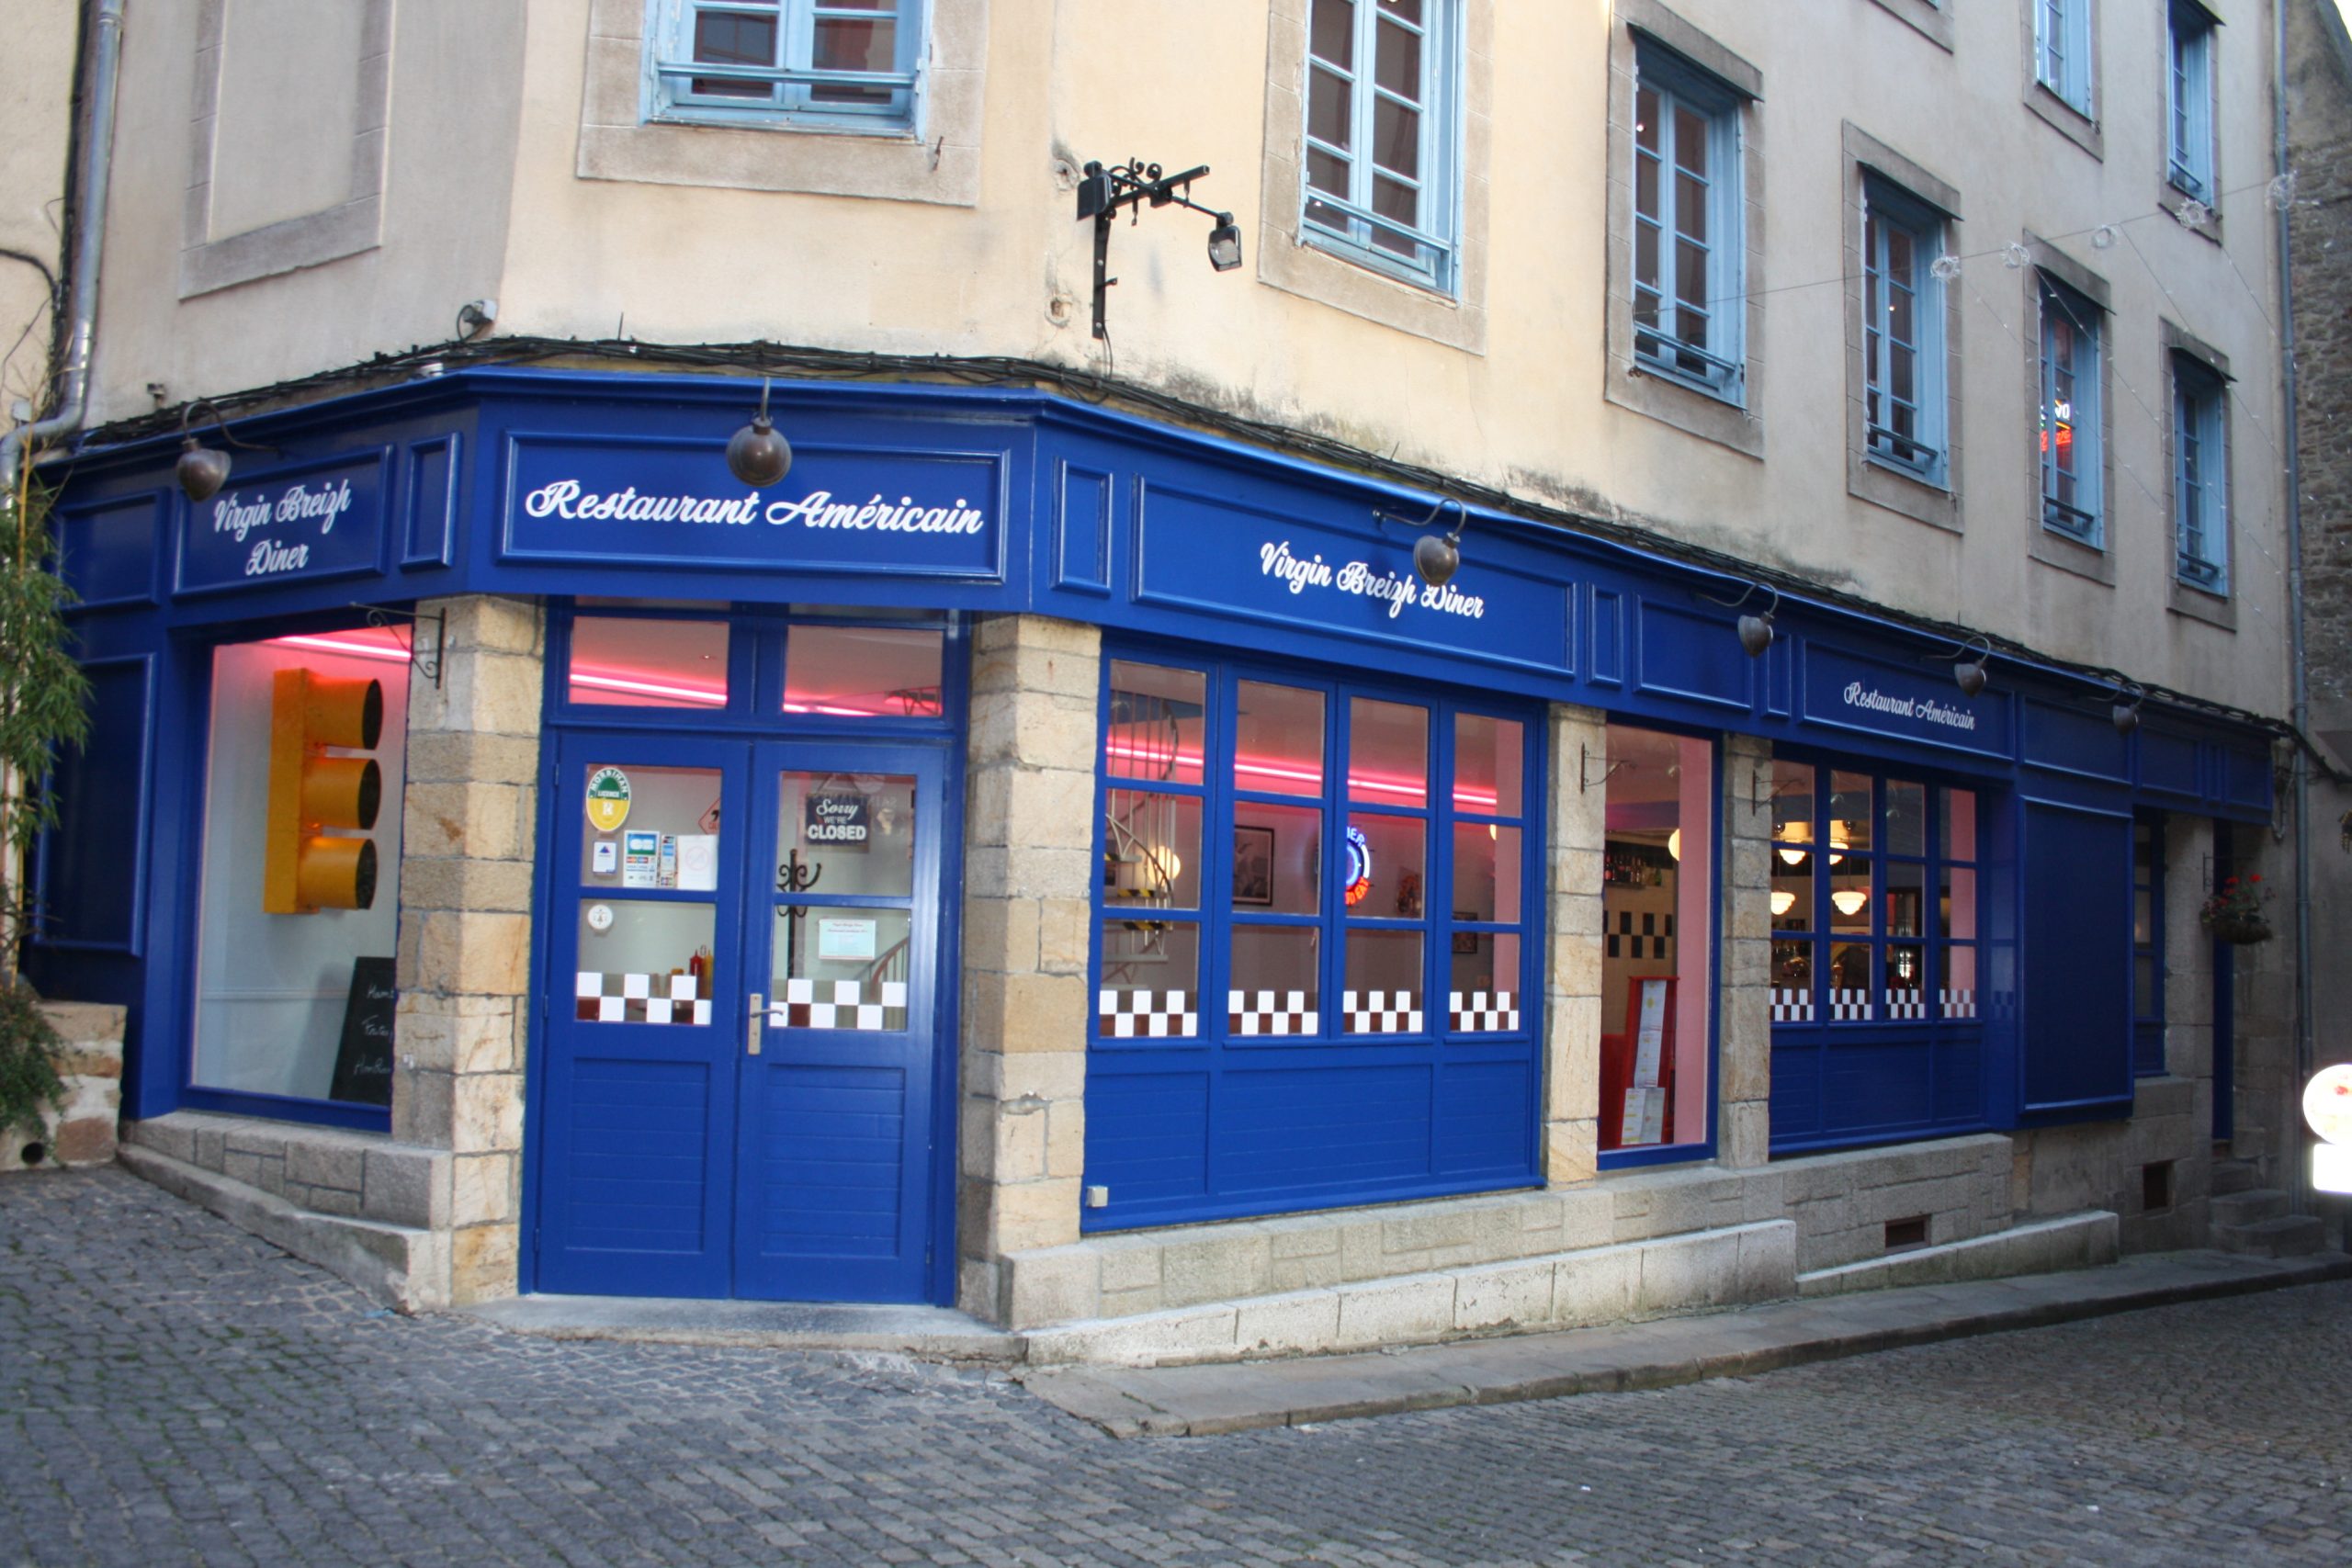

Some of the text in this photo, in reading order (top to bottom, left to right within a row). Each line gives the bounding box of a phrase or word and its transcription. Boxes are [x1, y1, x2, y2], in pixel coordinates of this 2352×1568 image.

[213, 479, 352, 542] Virgin Breizh
[525, 479, 984, 536] Restaurant Américain
[245, 538, 310, 576] Diner
[1260, 540, 1484, 618] Virgin Breizh Diner
[1843, 682, 1975, 730] Restaurant Américain
[589, 769, 629, 794] MORBIHAN
[816, 798, 859, 820] Sorry
[824, 816, 847, 825] WE'RE
[808, 824, 867, 840] CLOSED
